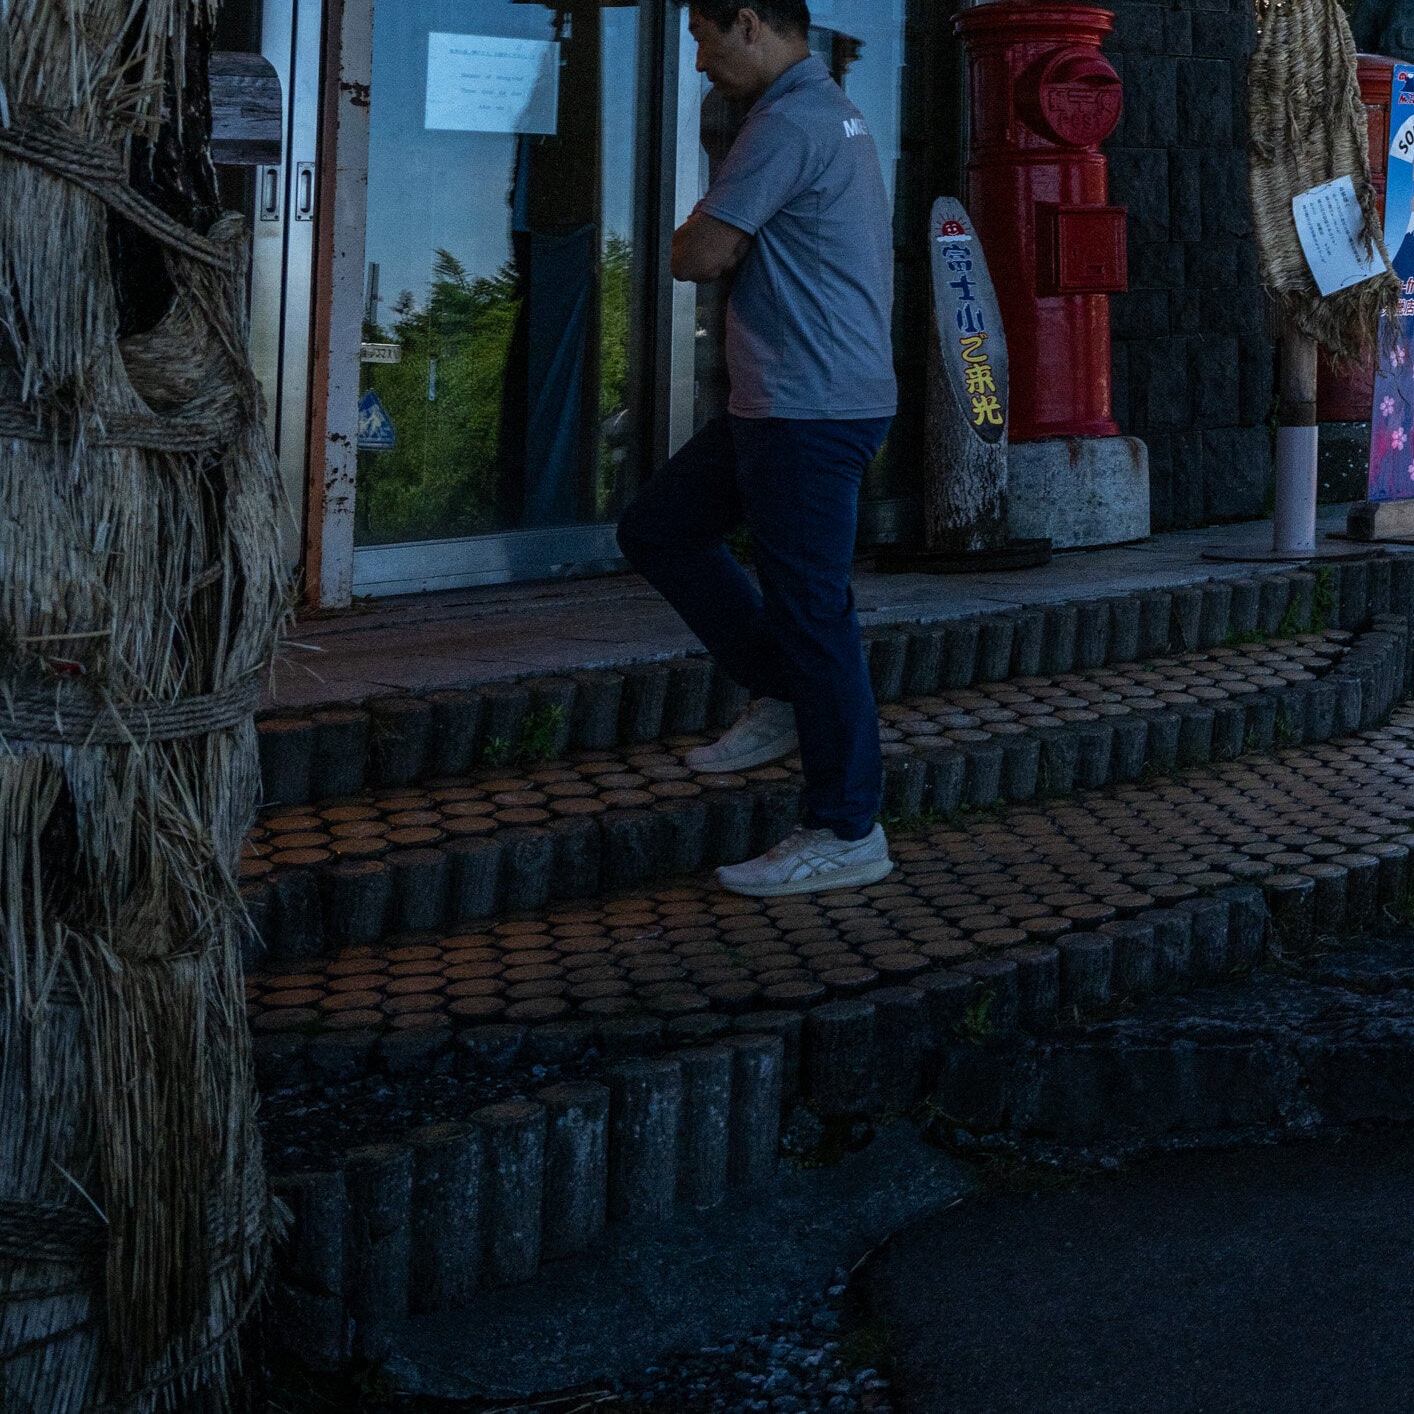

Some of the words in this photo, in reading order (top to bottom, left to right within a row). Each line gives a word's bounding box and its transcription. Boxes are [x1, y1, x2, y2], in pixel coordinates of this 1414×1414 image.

[942, 243, 1004, 426] 富士山ご来光
